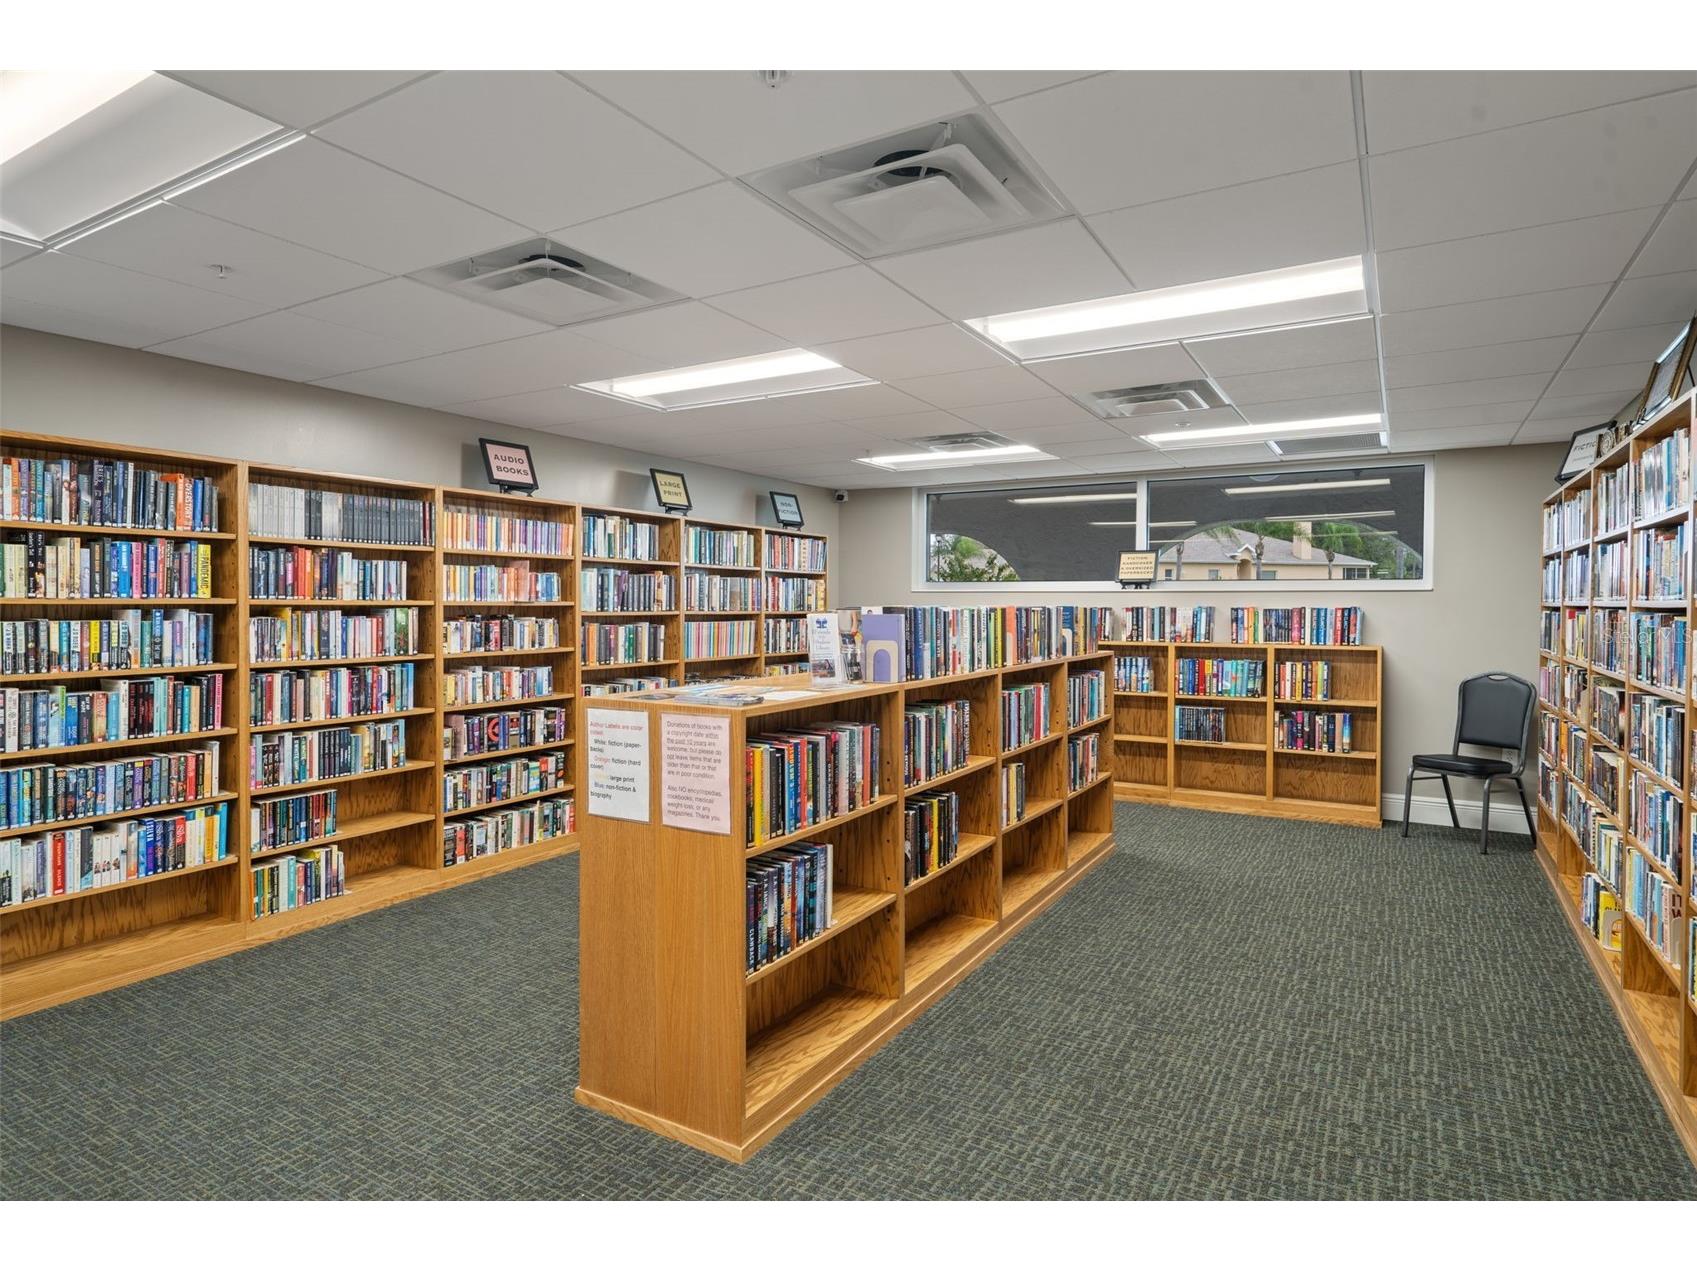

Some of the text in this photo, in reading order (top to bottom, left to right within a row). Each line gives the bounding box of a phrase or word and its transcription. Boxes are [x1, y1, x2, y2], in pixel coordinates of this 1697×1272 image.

[494, 454, 525, 465] AUDIO
[496, 465, 529, 476] BOOKS
[660, 480, 681, 489] LARGE
[663, 489, 683, 497] PRINT
[185, 482, 193, 519] OVERSTORY
[200, 556, 209, 589] PANDEMIC
[667, 720, 690, 728] Donations
[671, 730, 693, 738] copyright
[611, 757, 627, 765] fiction
[606, 784, 631, 792] non-fiction
[590, 791, 612, 800] biography
[695, 811, 710, 819] Thank
